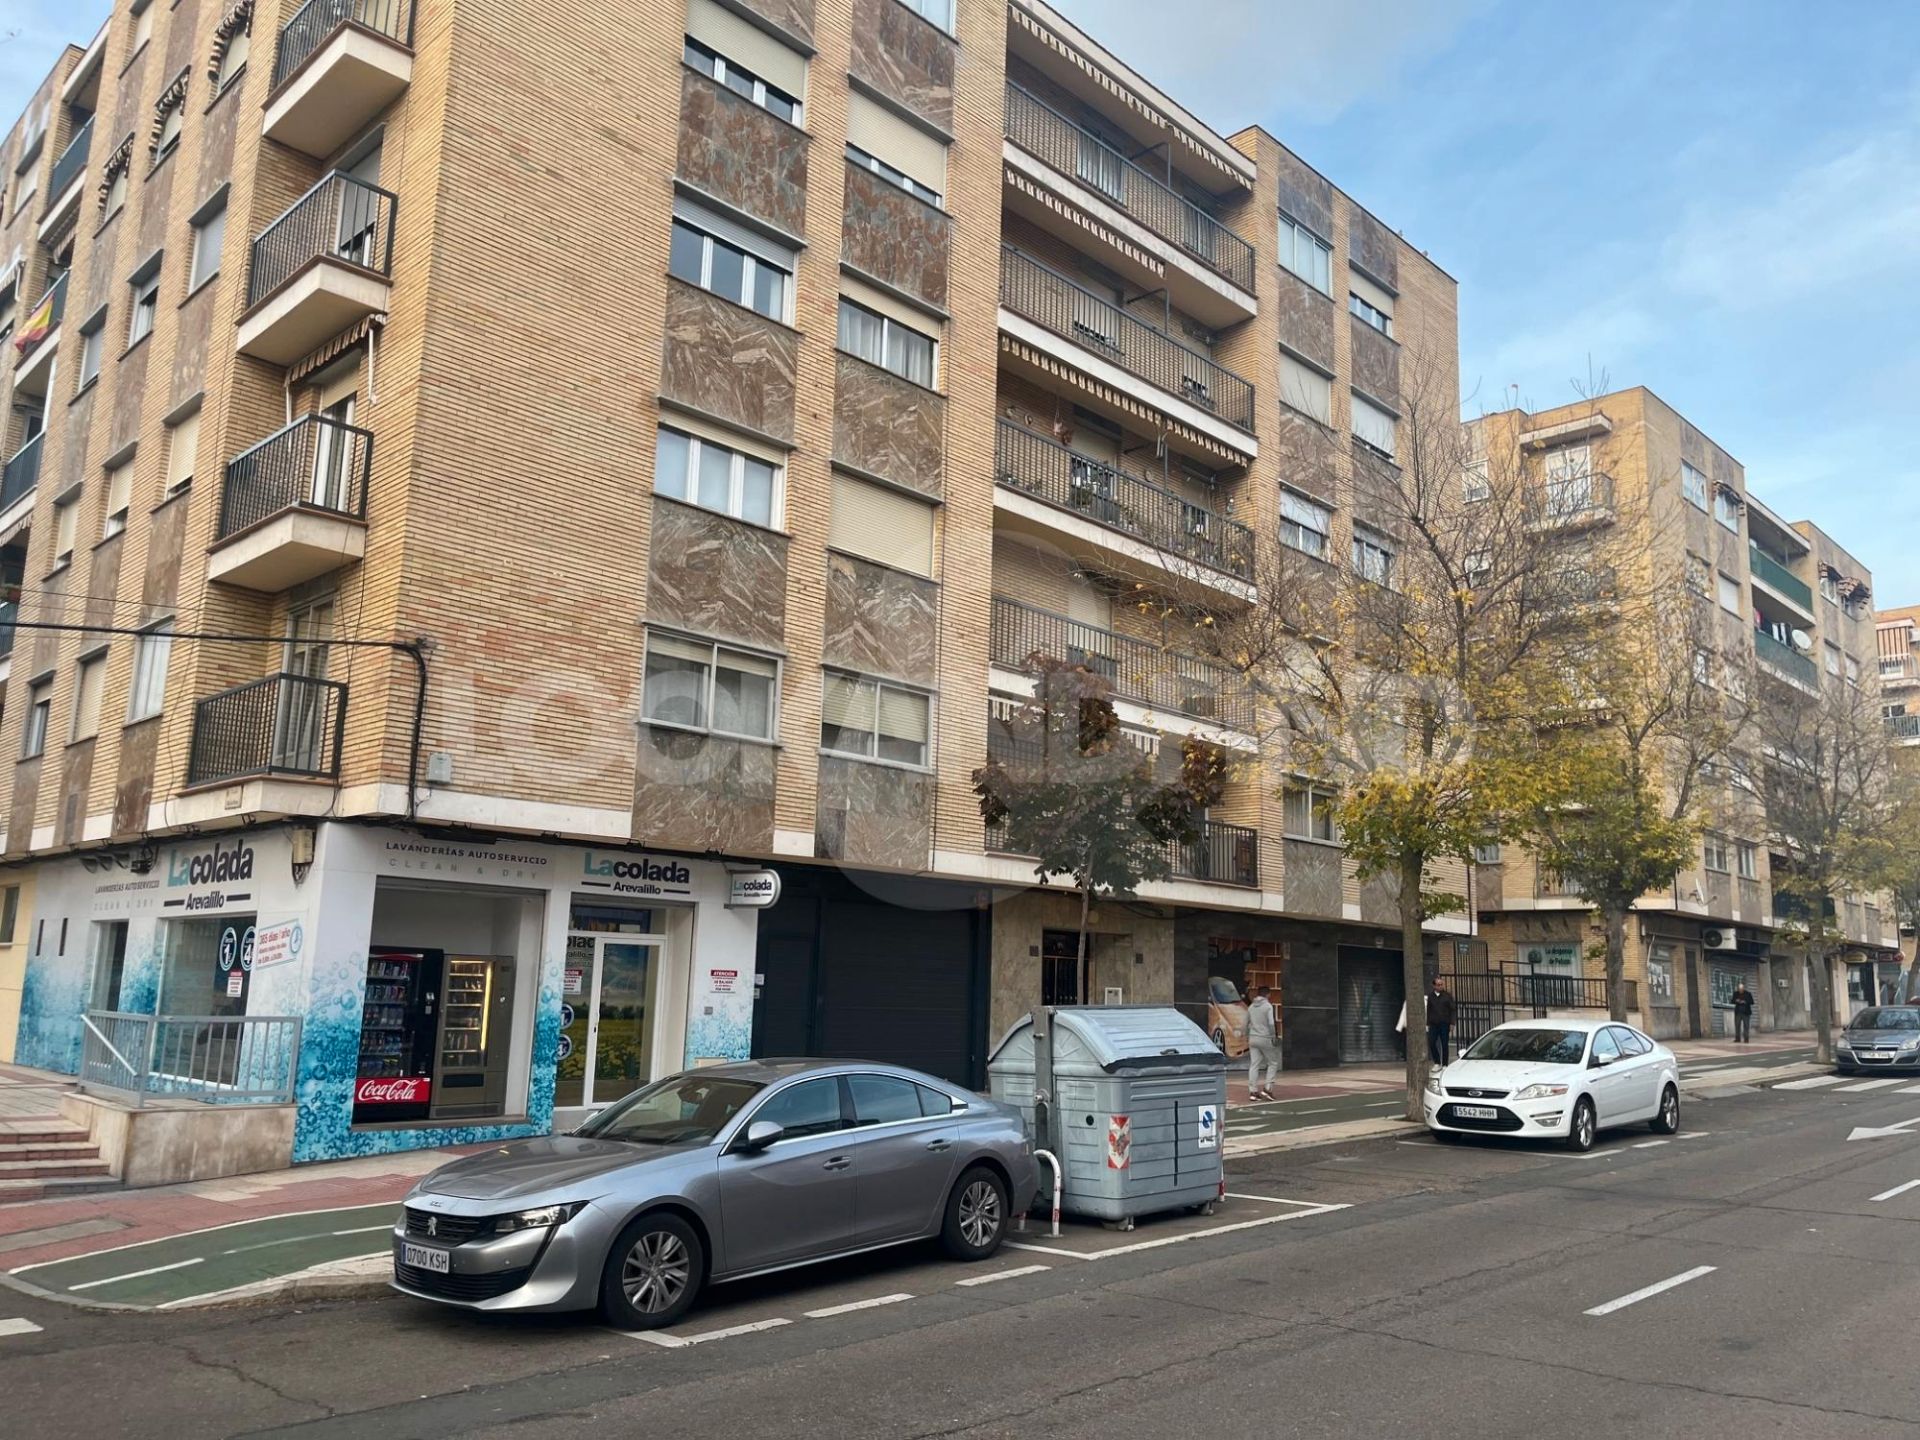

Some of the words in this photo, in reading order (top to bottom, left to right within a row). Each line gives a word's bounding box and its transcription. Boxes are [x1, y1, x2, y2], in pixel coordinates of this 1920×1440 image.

[167, 838, 255, 888] Lacolada
[386, 842, 465, 858] LAVANDERÍAS
[468, 851, 548, 866] AUTOSERVICIO
[388, 857, 458, 873] CLEAN
[476, 866, 484, 876] &
[502, 868, 538, 880] DRY
[583, 851, 690, 884] Lacolada
[612, 881, 662, 896] Arevalillo
[733, 879, 772, 892] Lacolada
[185, 890, 225, 911] Arevalillo
[358, 1079, 420, 1101] Coca-Cola
[1458, 1107, 1478, 1117] 5542
[1479, 1108, 1495, 1118] HHH
[406, 1246, 428, 1266] 0700
[428, 1251, 448, 1272] KSH
